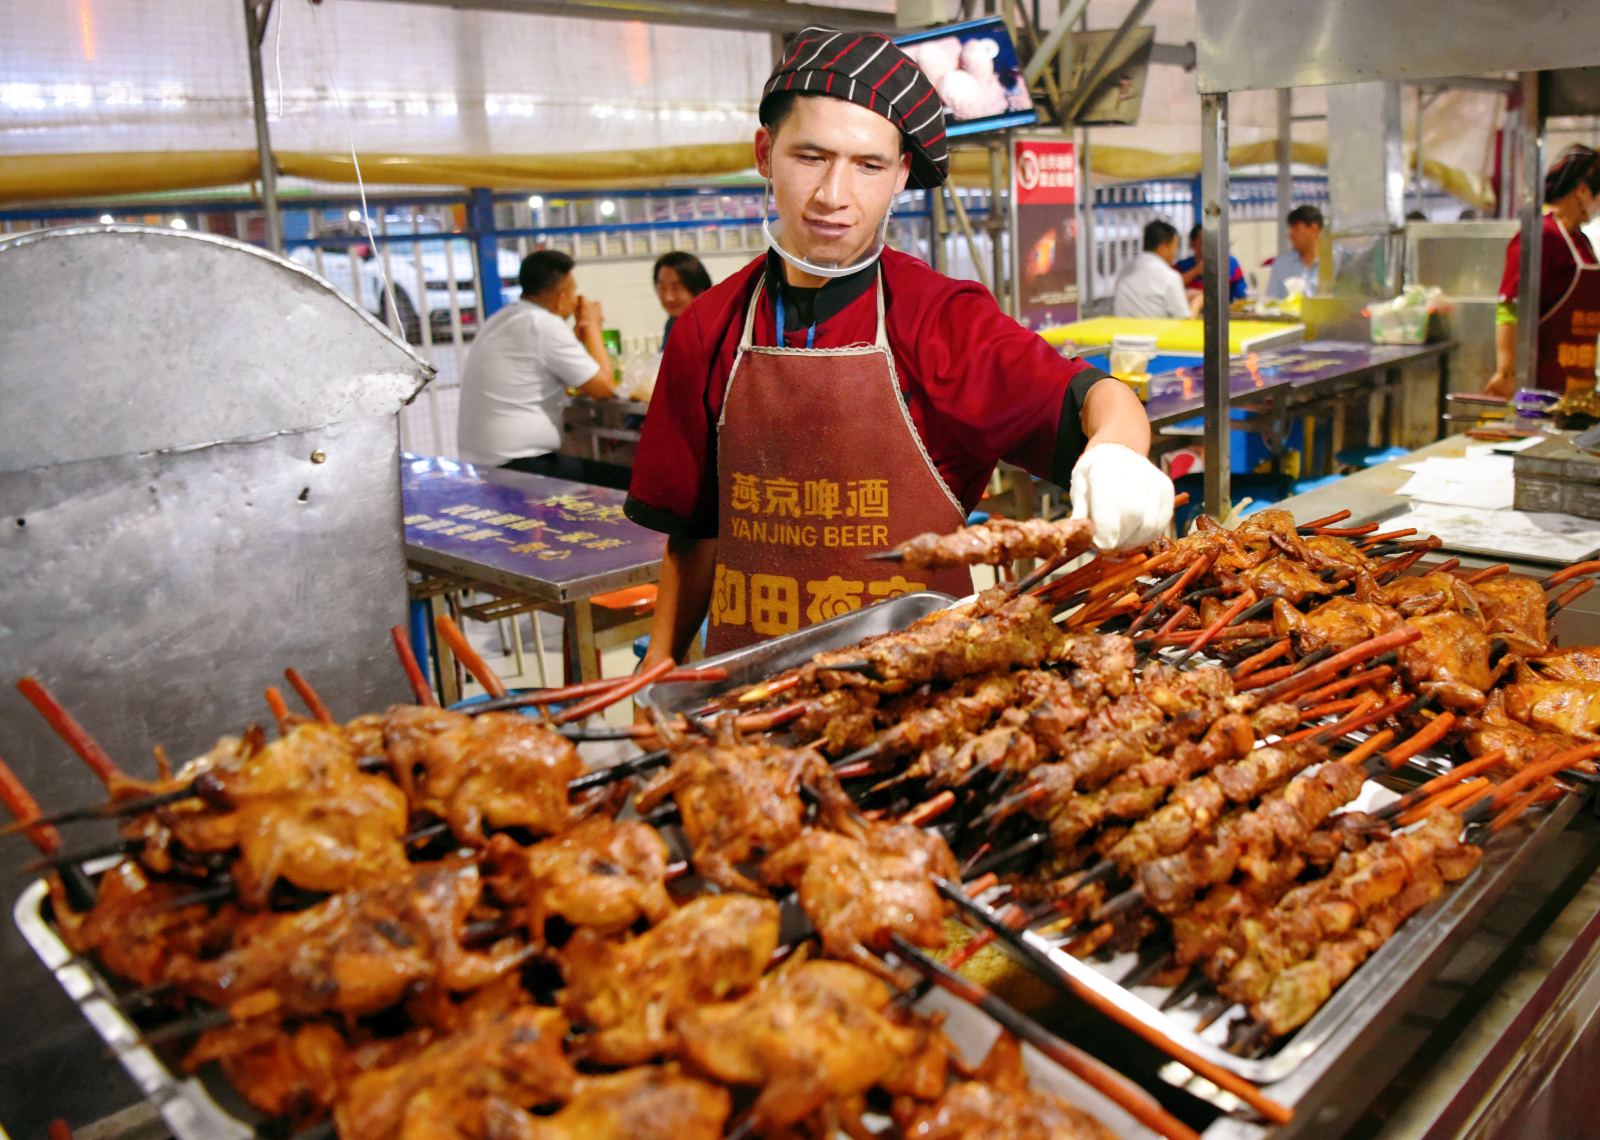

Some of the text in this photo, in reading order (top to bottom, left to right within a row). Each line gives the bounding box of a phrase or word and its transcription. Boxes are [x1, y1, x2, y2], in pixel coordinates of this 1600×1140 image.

[731, 471, 889, 519] 燕京啤酒
[731, 517, 889, 547] YANJING BEER
